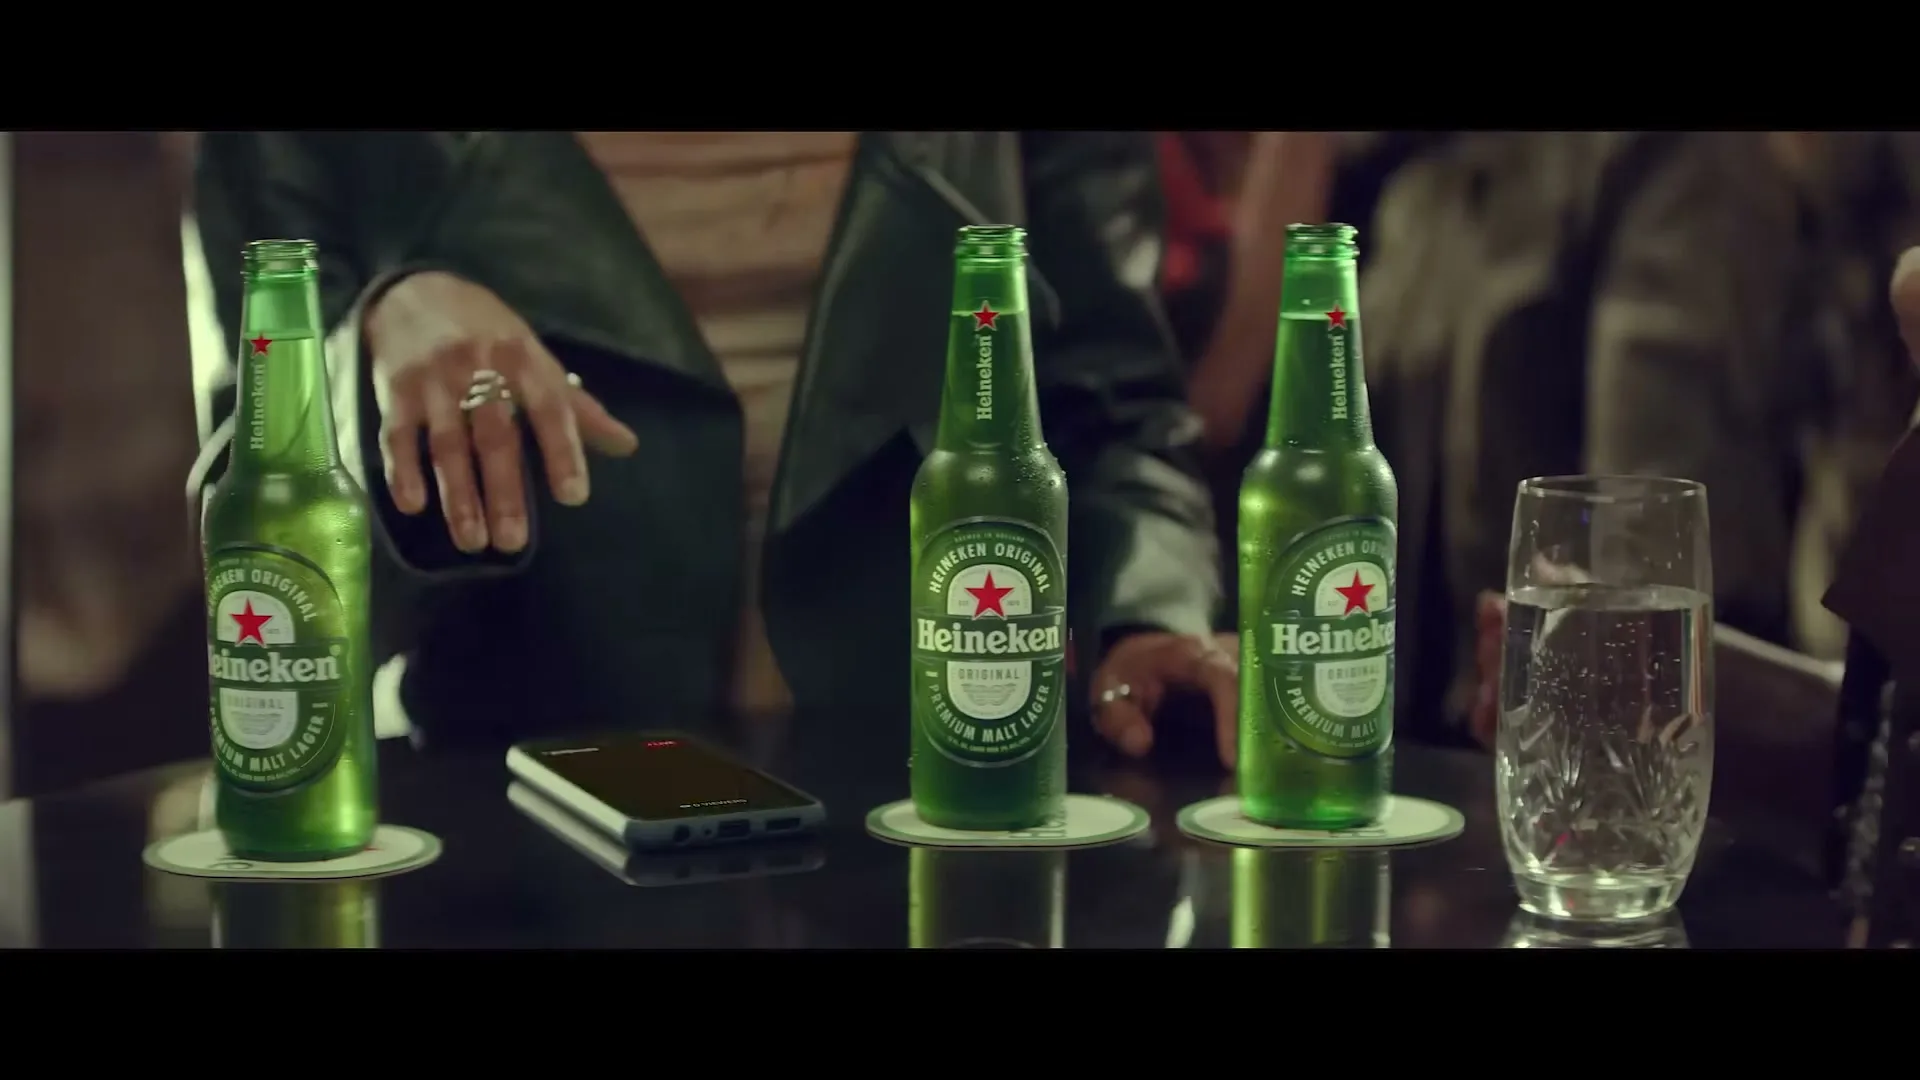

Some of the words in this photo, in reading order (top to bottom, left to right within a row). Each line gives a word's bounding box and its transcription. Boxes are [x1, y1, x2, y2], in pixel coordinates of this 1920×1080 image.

[976, 334, 993, 420] Heineken
[1329, 334, 1348, 420] Heineken
[250, 363, 266, 450] Heineken
[251, 568, 318, 622] ORIGINAL
[929, 542, 987, 593] HEINEKEN
[994, 542, 1051, 593] ORIGINAL
[1291, 541, 1355, 596] HEINEKEN
[916, 618, 1061, 655] Heineken
[958, 668, 1020, 681] ORIGINAL
[929, 684, 976, 740] PREMIUM
[982, 723, 1018, 743] MALT
[1020, 685, 1050, 729] LAGER
[1287, 687, 1345, 738] PREMIUM
[249, 753, 286, 773] MALT
[289, 715, 325, 760] LAGER
